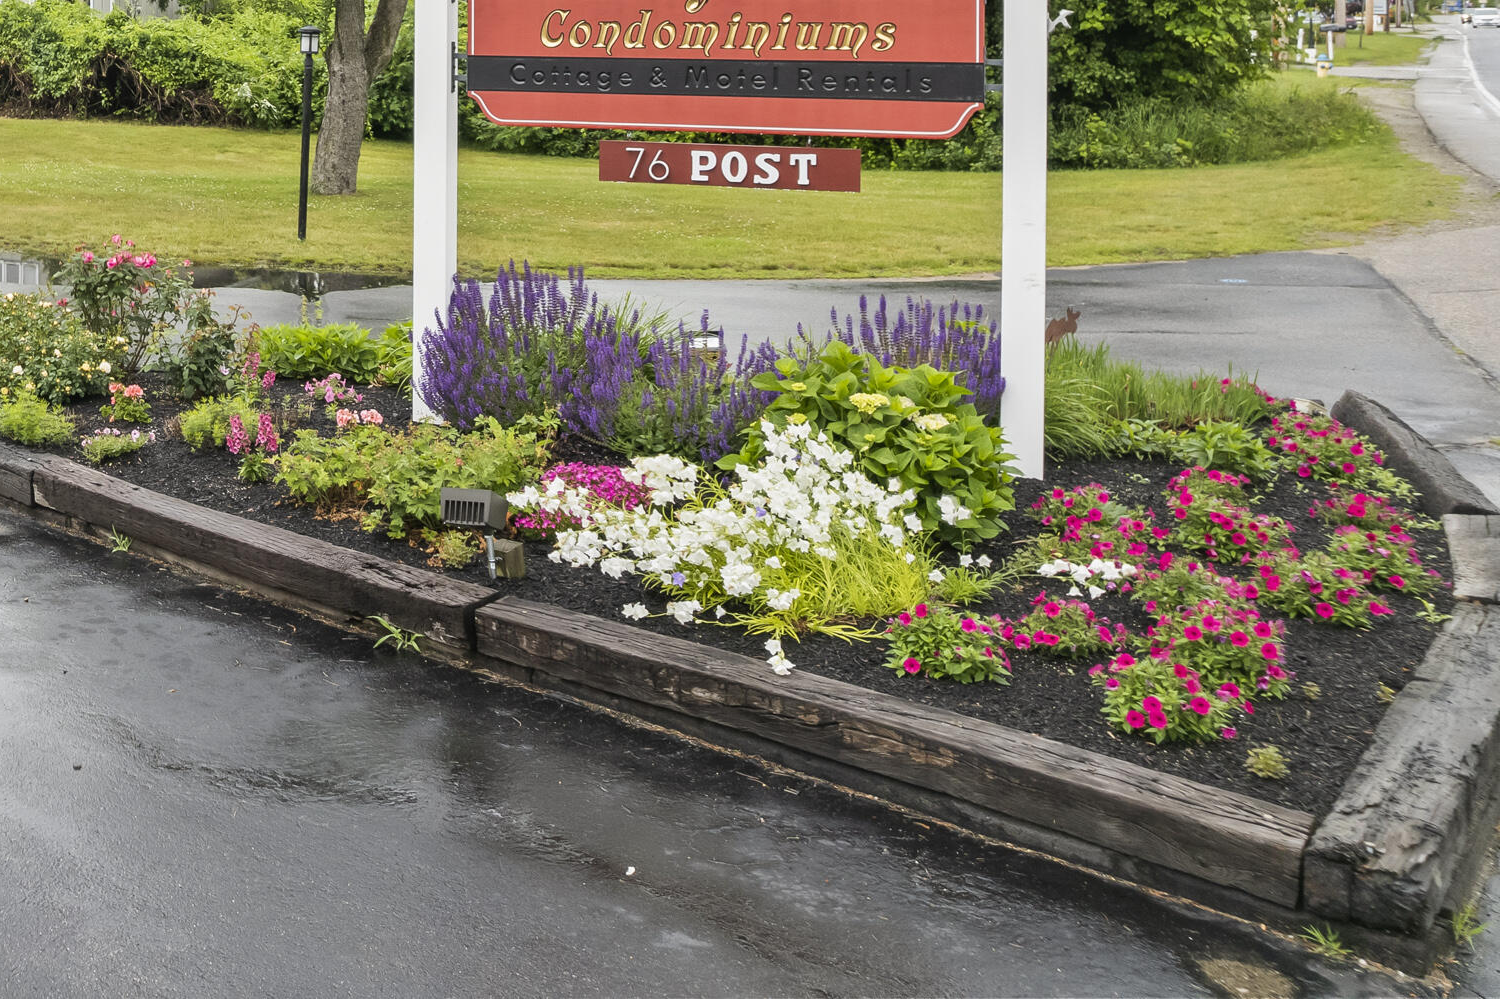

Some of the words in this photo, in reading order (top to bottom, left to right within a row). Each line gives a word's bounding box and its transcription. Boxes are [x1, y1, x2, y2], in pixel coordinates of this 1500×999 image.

[540, 10, 898, 59] Condominiums
[509, 63, 633, 92] Cottage
[649, 66, 668, 88] &
[684, 65, 779, 91] Motel
[797, 67, 933, 94] Rentals
[626, 148, 670, 181] 76
[690, 150, 818, 186] POST
